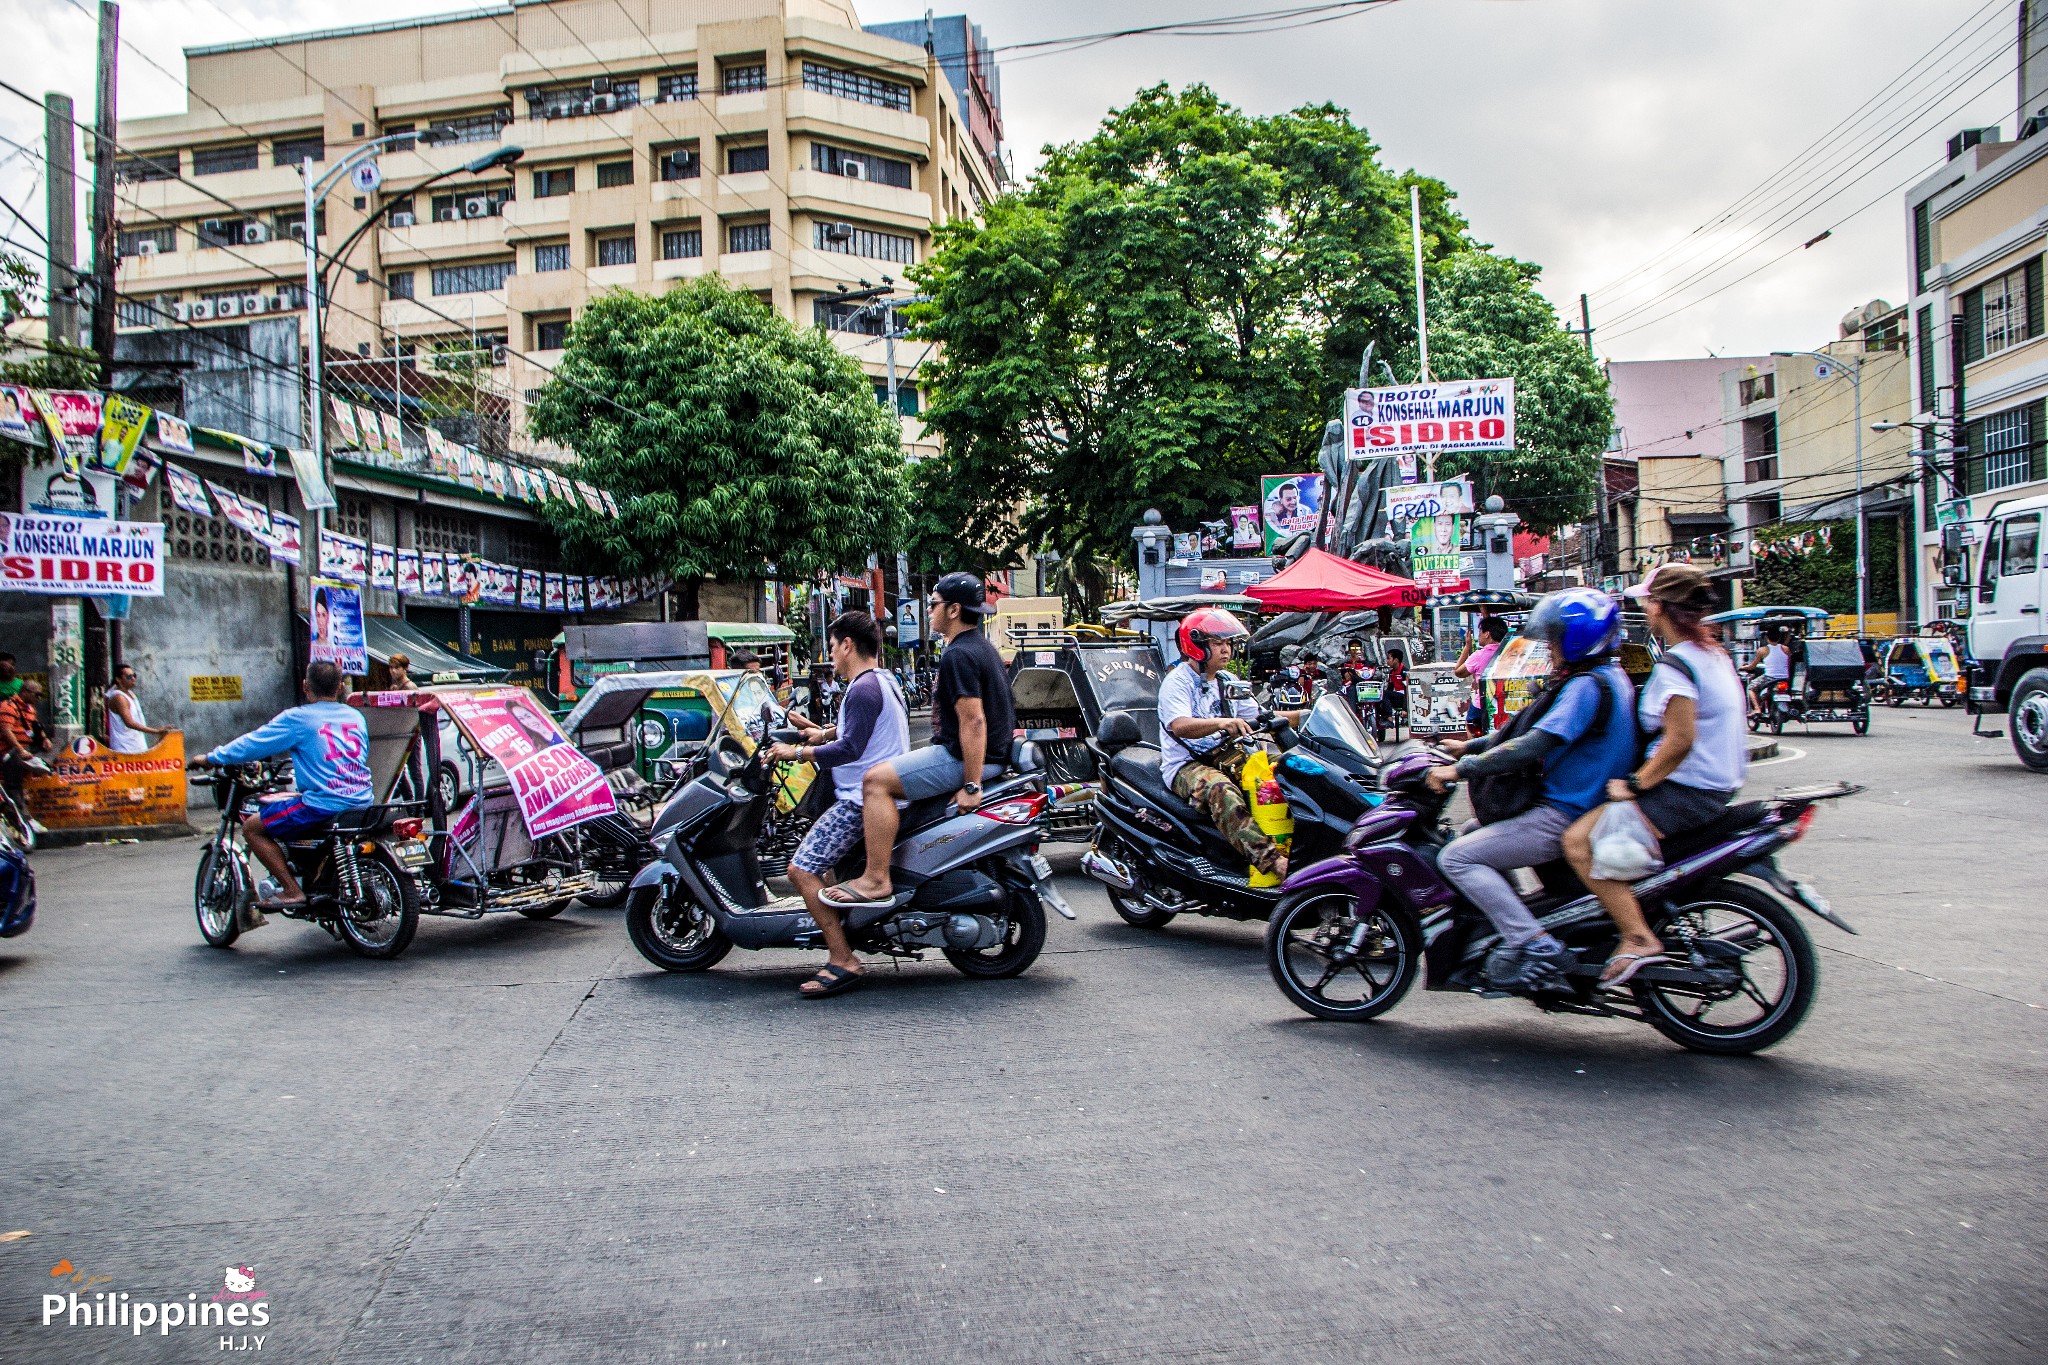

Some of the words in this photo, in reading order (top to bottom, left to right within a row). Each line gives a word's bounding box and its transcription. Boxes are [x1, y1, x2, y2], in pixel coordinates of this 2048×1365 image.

[1378, 388, 1437, 403] IBOTO!
[1378, 401, 1434, 423] KONSEHAL
[1437, 396, 1504, 419] MARJUN
[1355, 416, 1370, 426] 14
[1353, 418, 1505, 448] ISIDRO
[1369, 446, 1399, 455] DATING
[1414, 493, 1437, 501] JOSEPH
[14, 519, 82, 534] IBOTO!
[14, 532, 80, 556] KONSEHAL
[83, 536, 154, 559] MARJUN
[1414, 555, 1459, 571] DUTERTE
[1098, 660, 1157, 683] JEROME
[318, 723, 361, 761] 15
[481, 723, 519, 750] VOTE!
[510, 736, 534, 754] 15
[102, 757, 183, 775] BORROMEO
[513, 744, 584, 796] JUSON
[525, 788, 553, 818] AVA
[550, 760, 598, 799] ALFONSO
